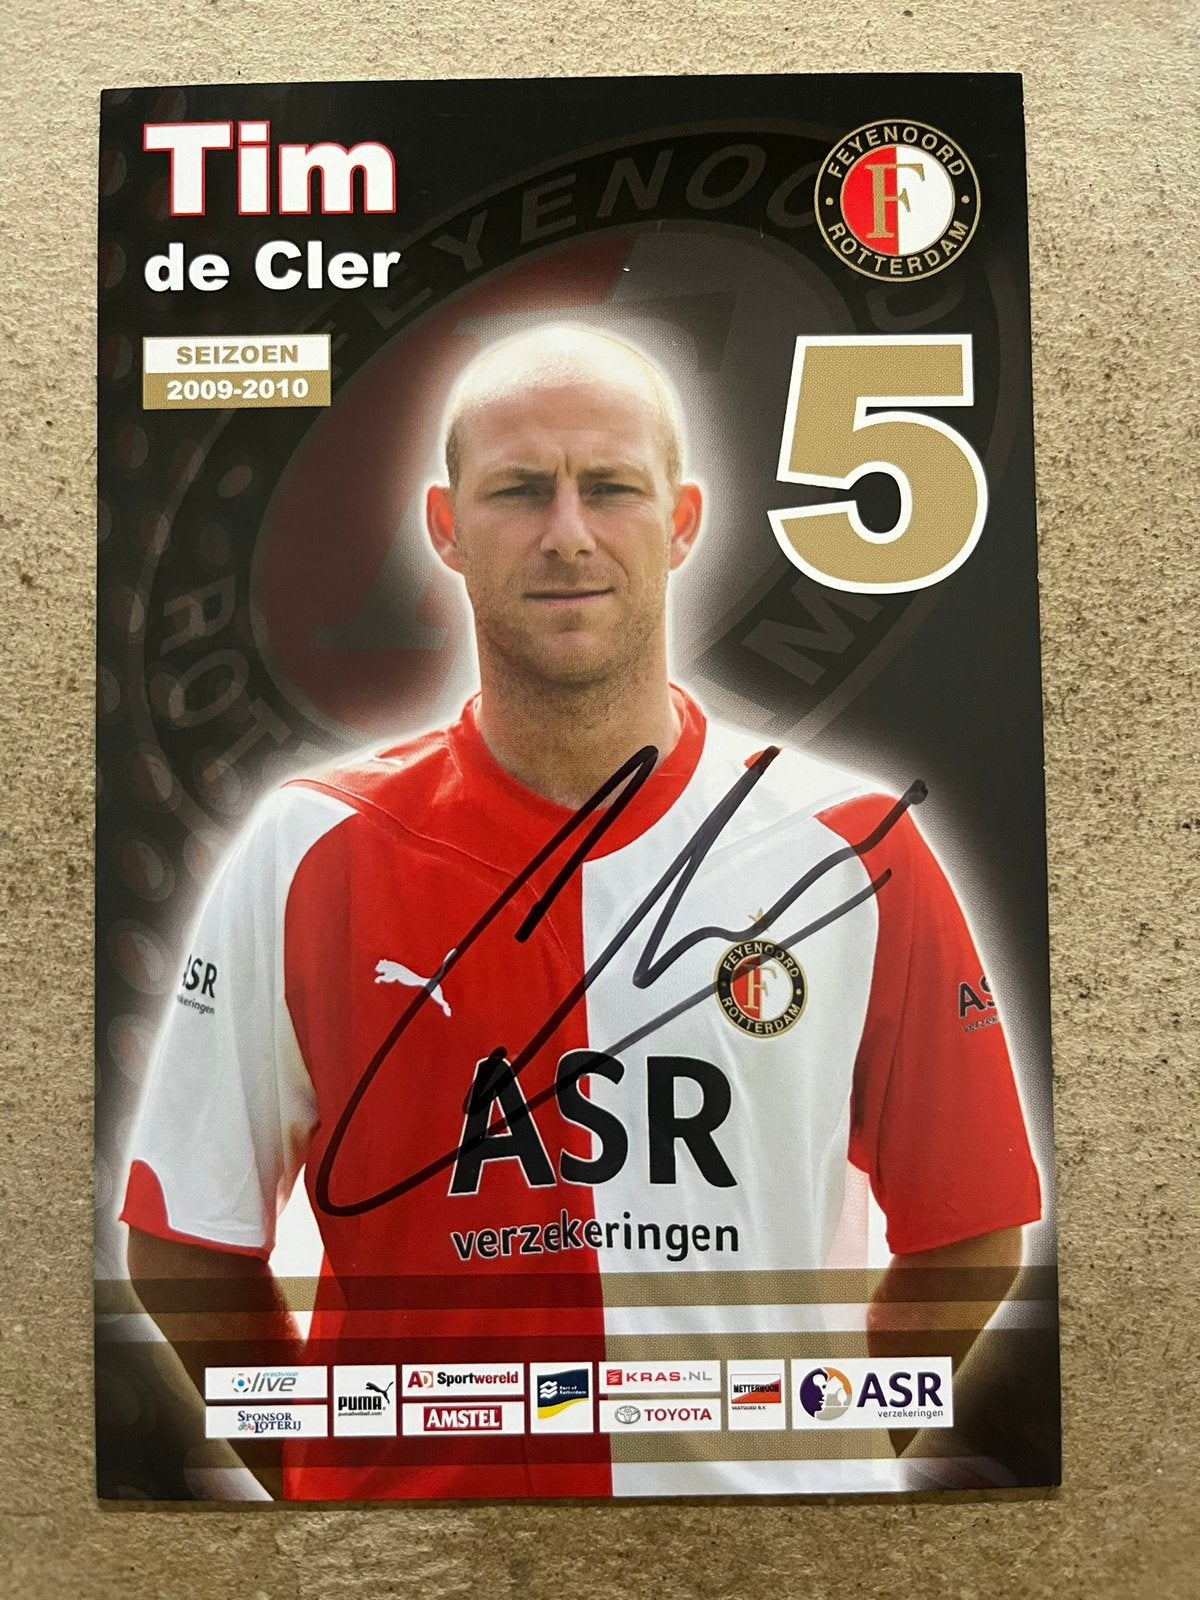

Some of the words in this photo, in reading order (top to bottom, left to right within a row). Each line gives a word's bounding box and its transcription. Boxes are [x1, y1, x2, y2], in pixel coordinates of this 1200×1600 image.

[827, 126, 965, 178] FEYENOORD
[143, 121, 396, 216] Tim
[828, 220, 969, 275] ROTTERDAM
[144, 242, 230, 292] de
[254, 240, 401, 290] Cler
[176, 345, 299, 366] SEIZOEN
[166, 378, 309, 401] 2009-2010
[767, 333, 989, 594] 5
[182, 954, 217, 998] SR
[722, 997, 800, 1034] ROTTERDAM
[447, 1049, 738, 1196] ASR
[450, 1209, 739, 1262] verzekeringen
[251, 1372, 297, 1392] live
[407, 1371, 434, 1388] AD
[437, 1371, 519, 1387] Sportwereld
[626, 1371, 713, 1382] KRAS.NL
[856, 1371, 943, 1407] ASR
[338, 1396, 382, 1411] PUMA
[644, 1408, 712, 1421] TOYOTA
[878, 1408, 943, 1419] verzekeringen
[237, 1410, 293, 1422] SPONSOR
[254, 1420, 302, 1434] LOTERIJ
[426, 1408, 500, 1428] AMSTEL
